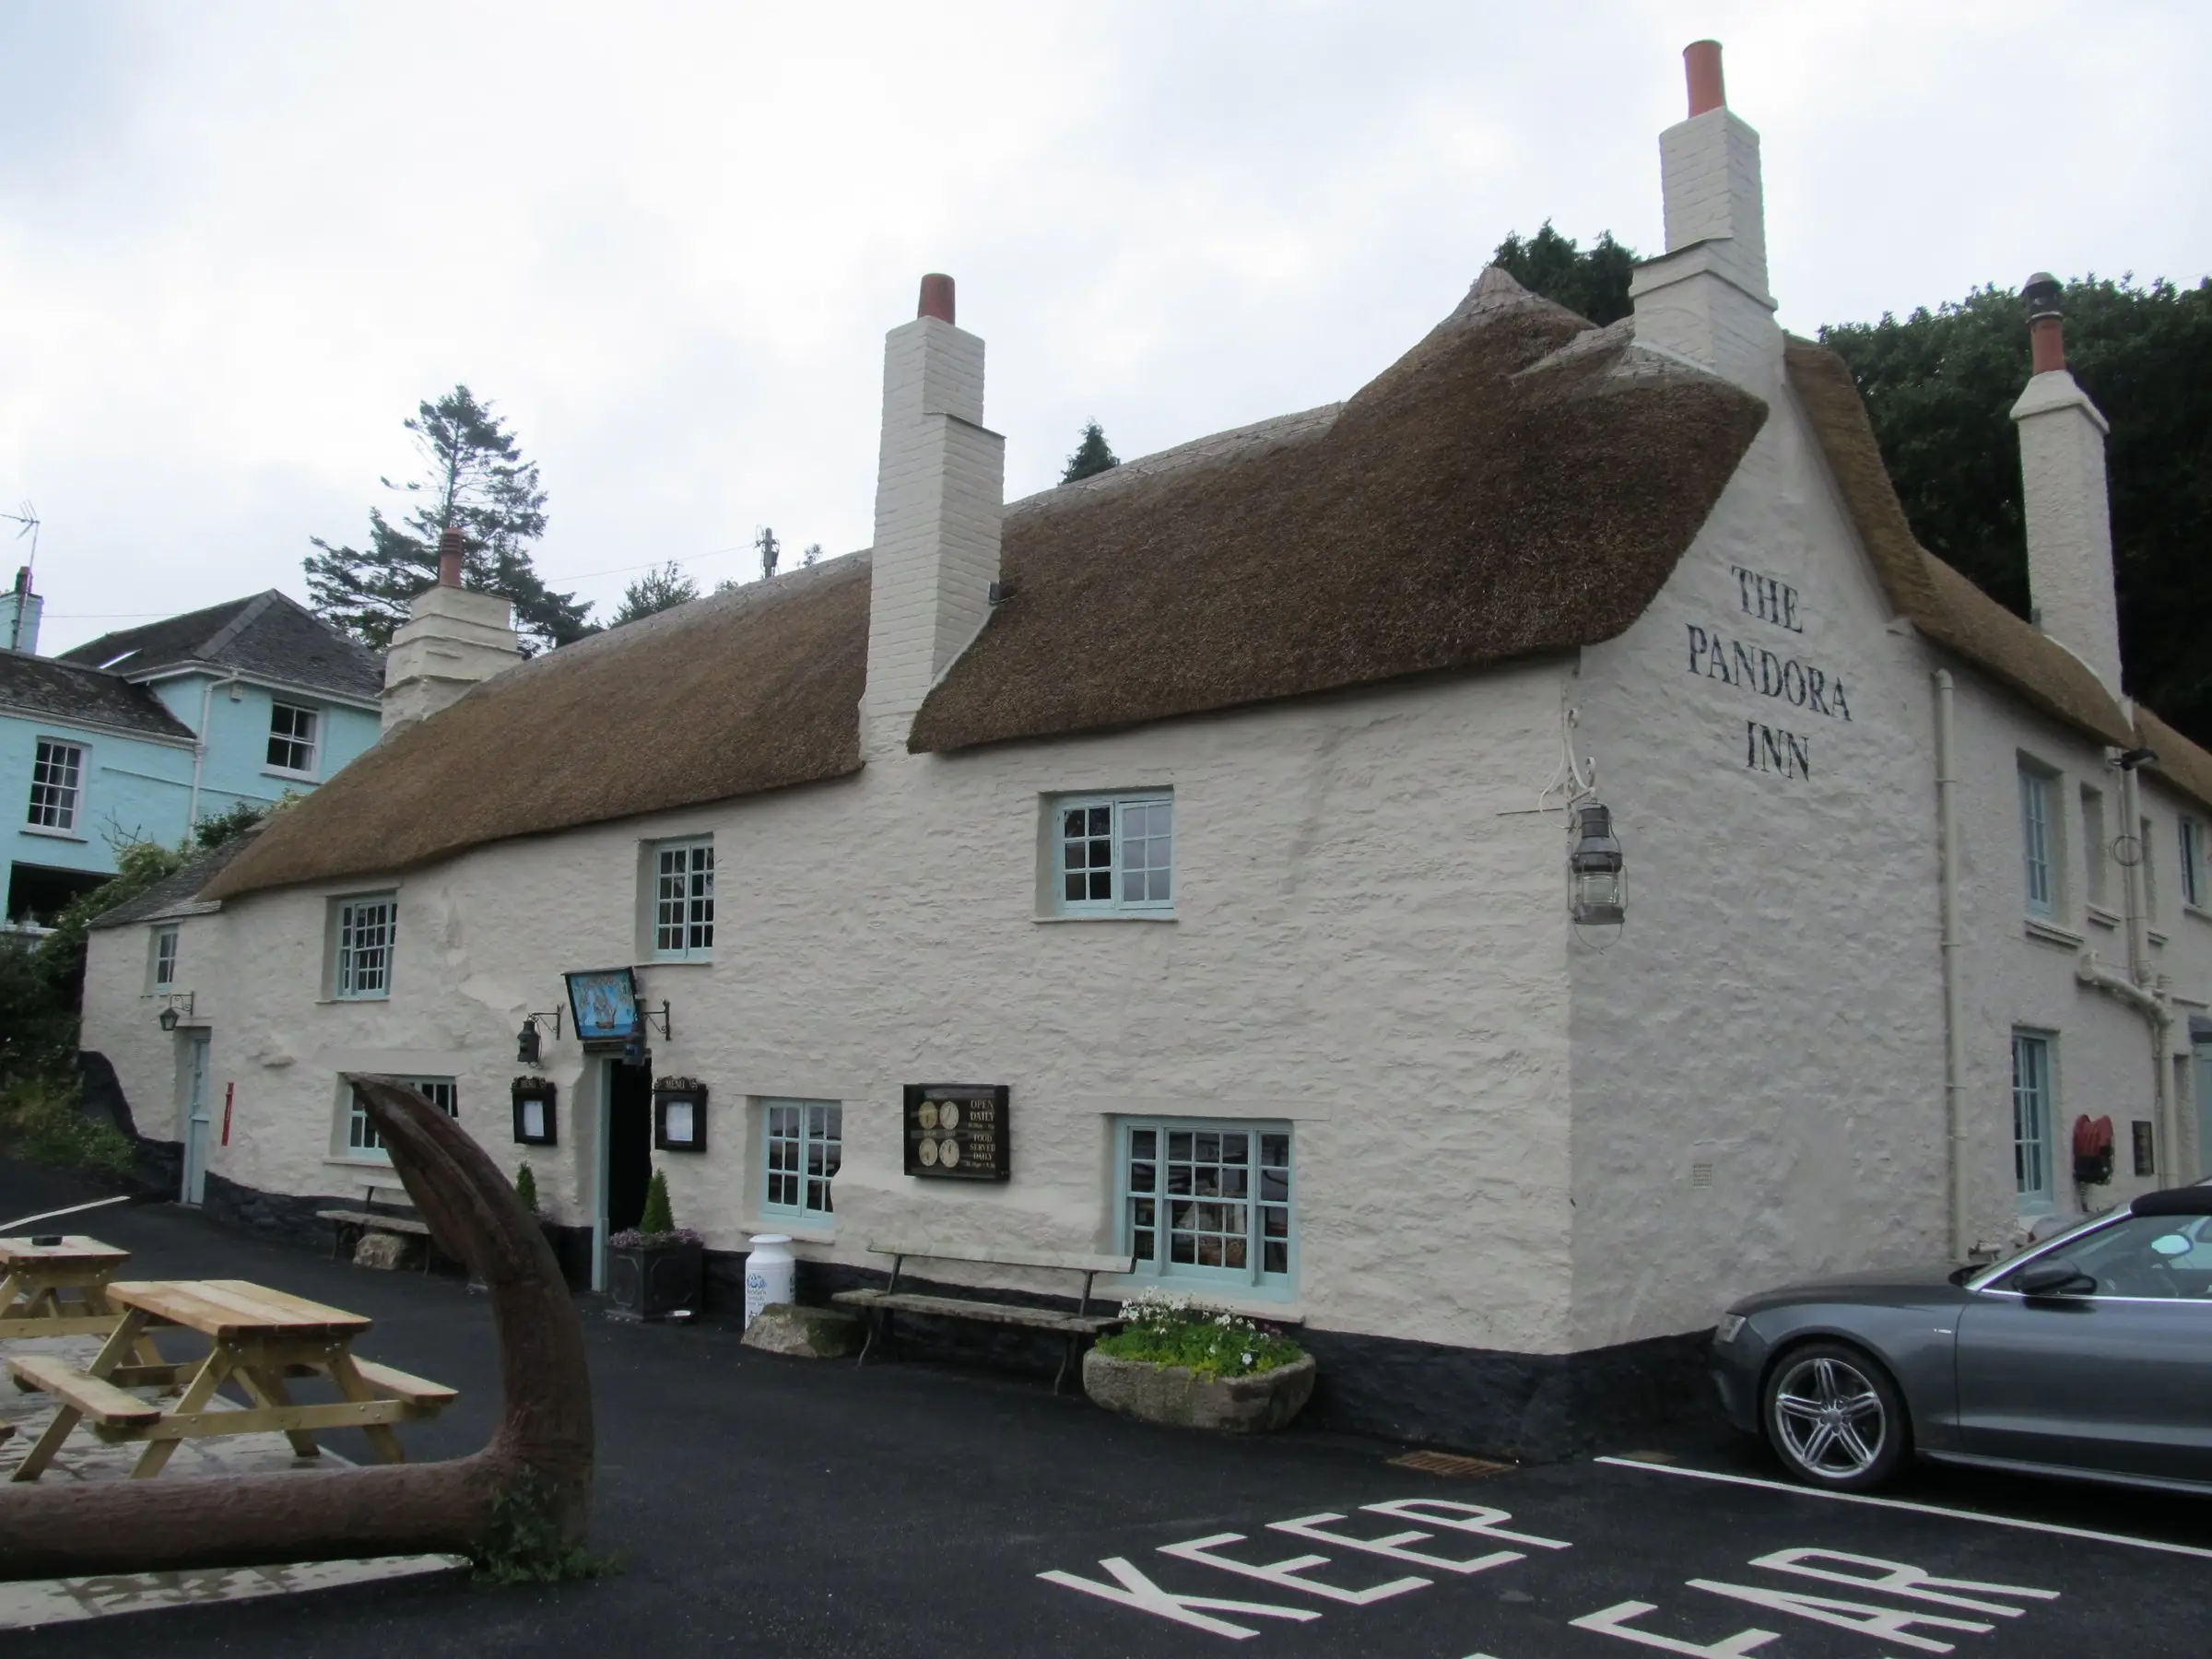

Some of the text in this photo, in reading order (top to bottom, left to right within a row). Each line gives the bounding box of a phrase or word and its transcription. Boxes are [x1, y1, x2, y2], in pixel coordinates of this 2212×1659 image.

[1731, 564, 1803, 633] THE
[1685, 623, 1853, 722] PANDORA
[1747, 720, 1809, 782] INN
[971, 1099, 994, 1110] OPEN
[970, 1111, 994, 1122] DAILY
[973, 1134, 993, 1142] FOOD
[970, 1143, 995, 1152] SERVED
[973, 1152, 993, 1161] DAILY
[1036, 1498, 1573, 1641] KEEP
